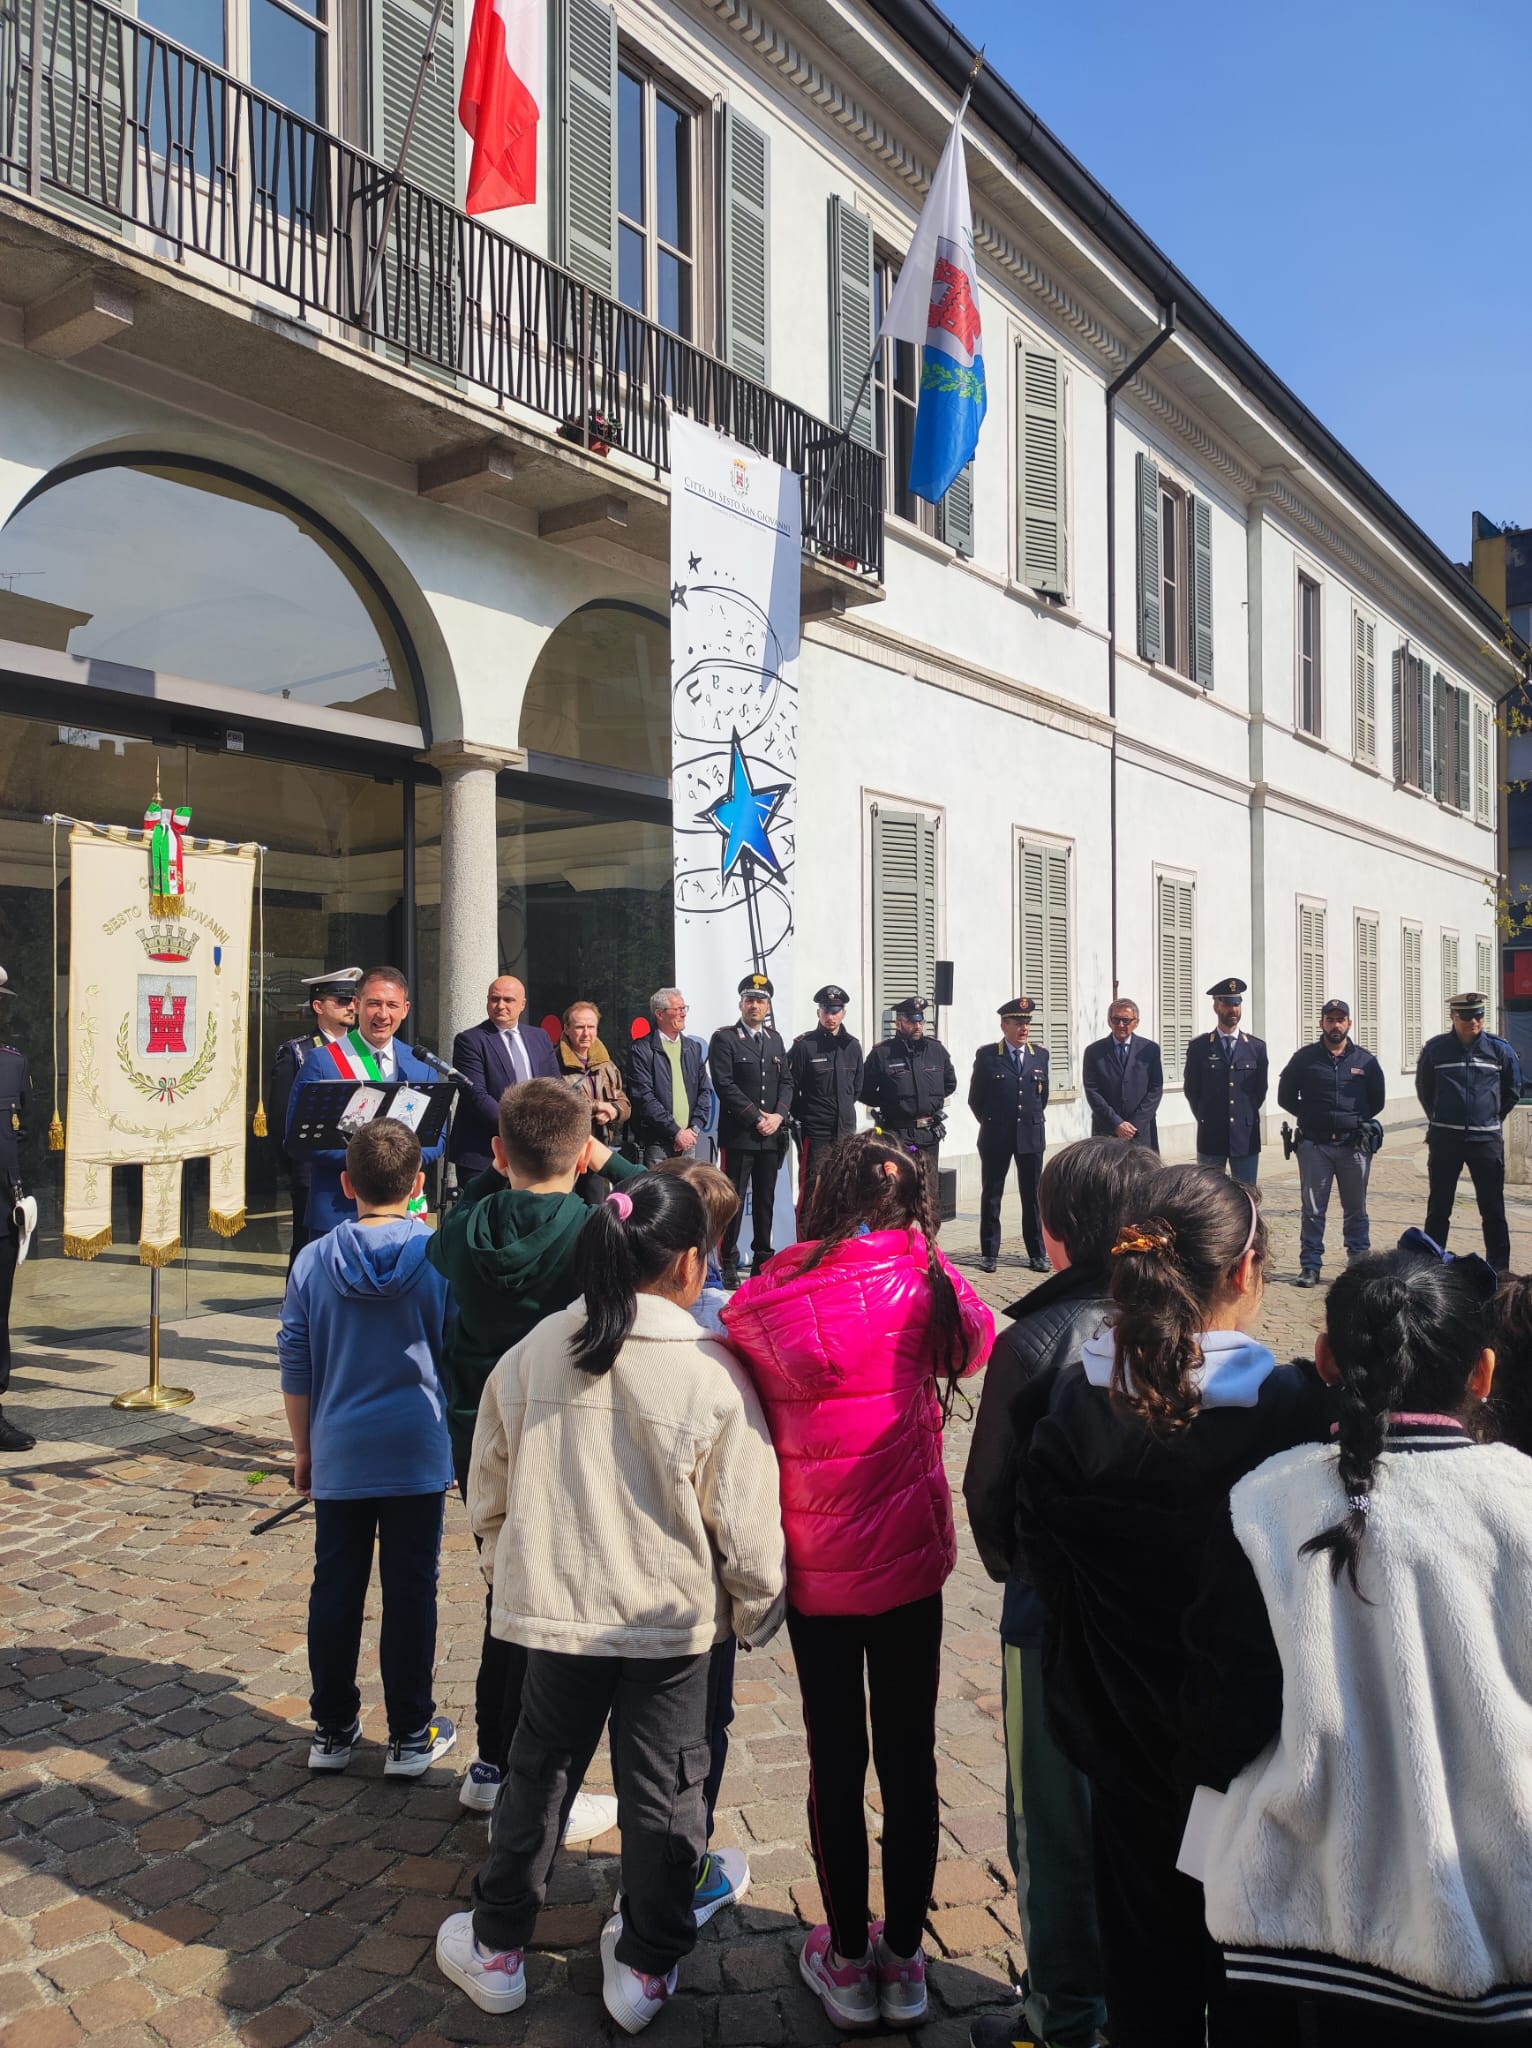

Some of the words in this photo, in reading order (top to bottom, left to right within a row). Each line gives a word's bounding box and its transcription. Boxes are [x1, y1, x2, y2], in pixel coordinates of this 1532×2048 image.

[718, 492, 741, 510] SESTO
[742, 503, 756, 517] SAN
[757, 511, 791, 534] GIOVANNI
[102, 906, 142, 936] SESTO
